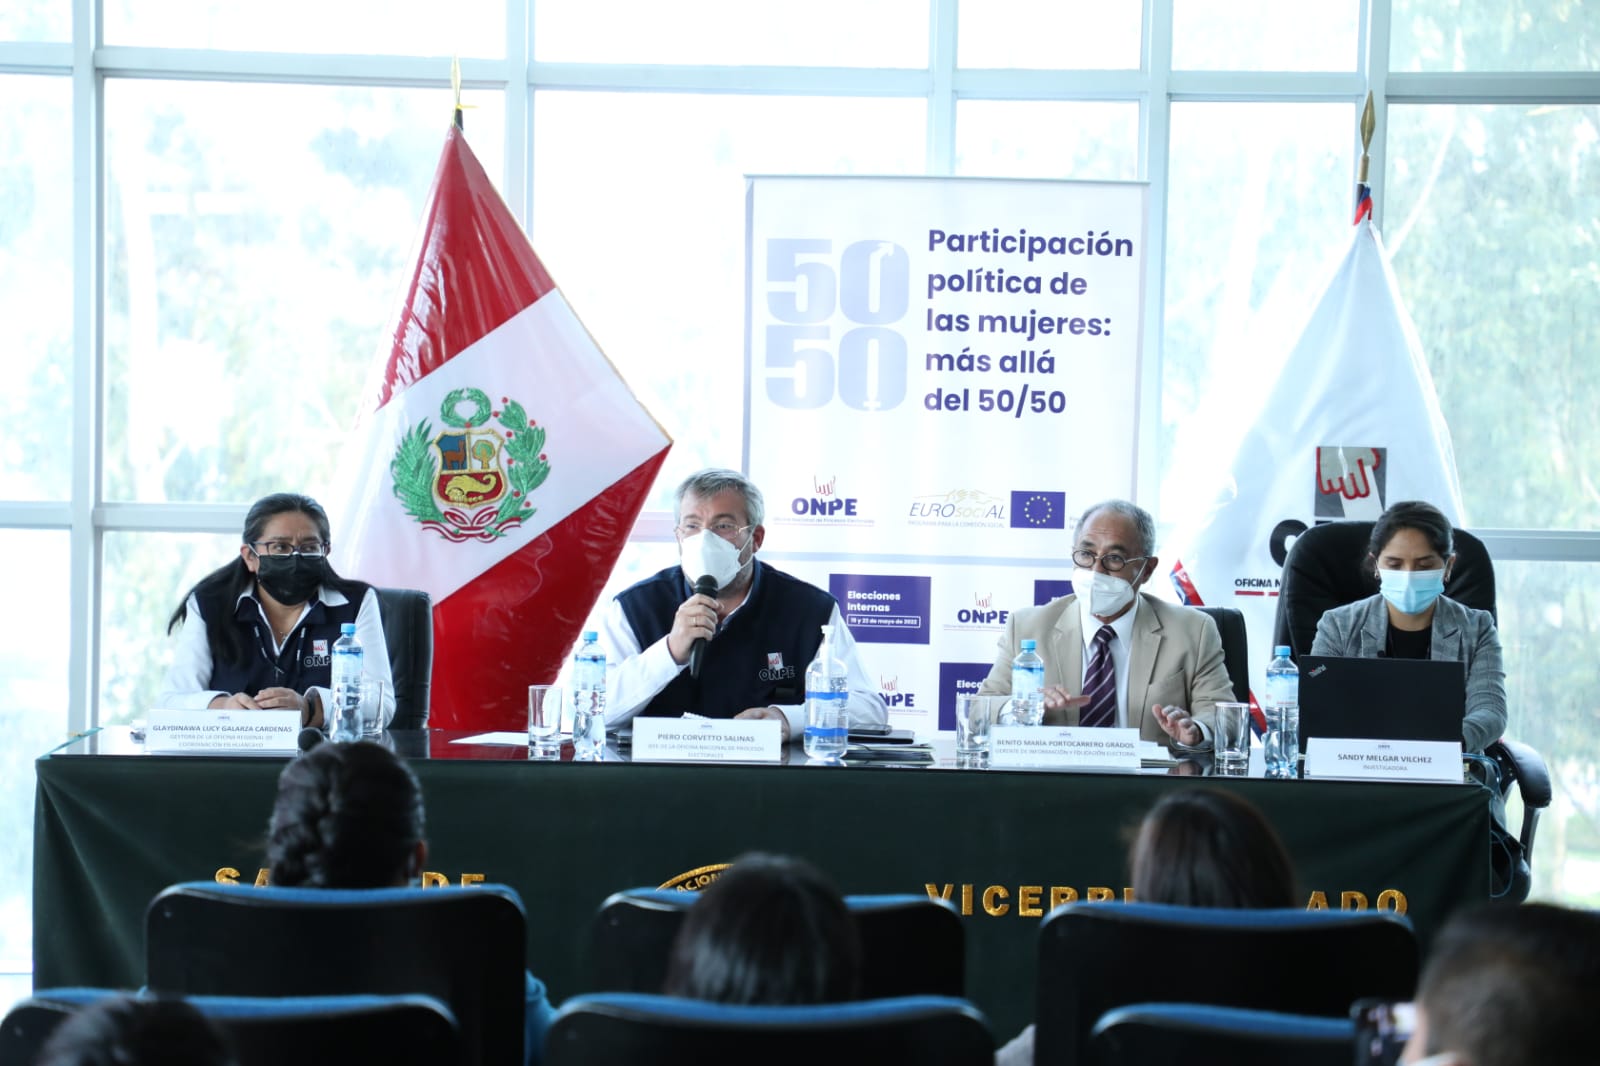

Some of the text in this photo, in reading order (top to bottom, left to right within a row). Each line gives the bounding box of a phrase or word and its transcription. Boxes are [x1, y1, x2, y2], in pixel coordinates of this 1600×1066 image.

[928, 228, 1133, 261] Participación
[766, 238, 910, 325] 50
[927, 267, 1087, 299] política de
[926, 308, 1112, 342] las mujeres:
[765, 324, 908, 411] 50
[925, 347, 1055, 374] más allá
[923, 384, 1066, 418] del 50/50
[791, 497, 858, 516] ONPE
[1234, 578, 1272, 587] OFICINA
[847, 590, 901, 601] Elecciones
[847, 602, 890, 612] Internas
[957, 609, 1009, 624] ONPE
[304, 655, 332, 668] ONP
[759, 665, 796, 681] ONPE
[878, 692, 915, 707] NPE
[657, 733, 755, 743] PIERO CORVETTO SALINAS
[997, 738, 1023, 746] BENITO
[1023, 739, 1048, 747] MARÍA
[1048, 740, 1104, 748] PORTOCARRERO
[1337, 753, 1432, 764] SANDY MELGAR VILCHEZ
